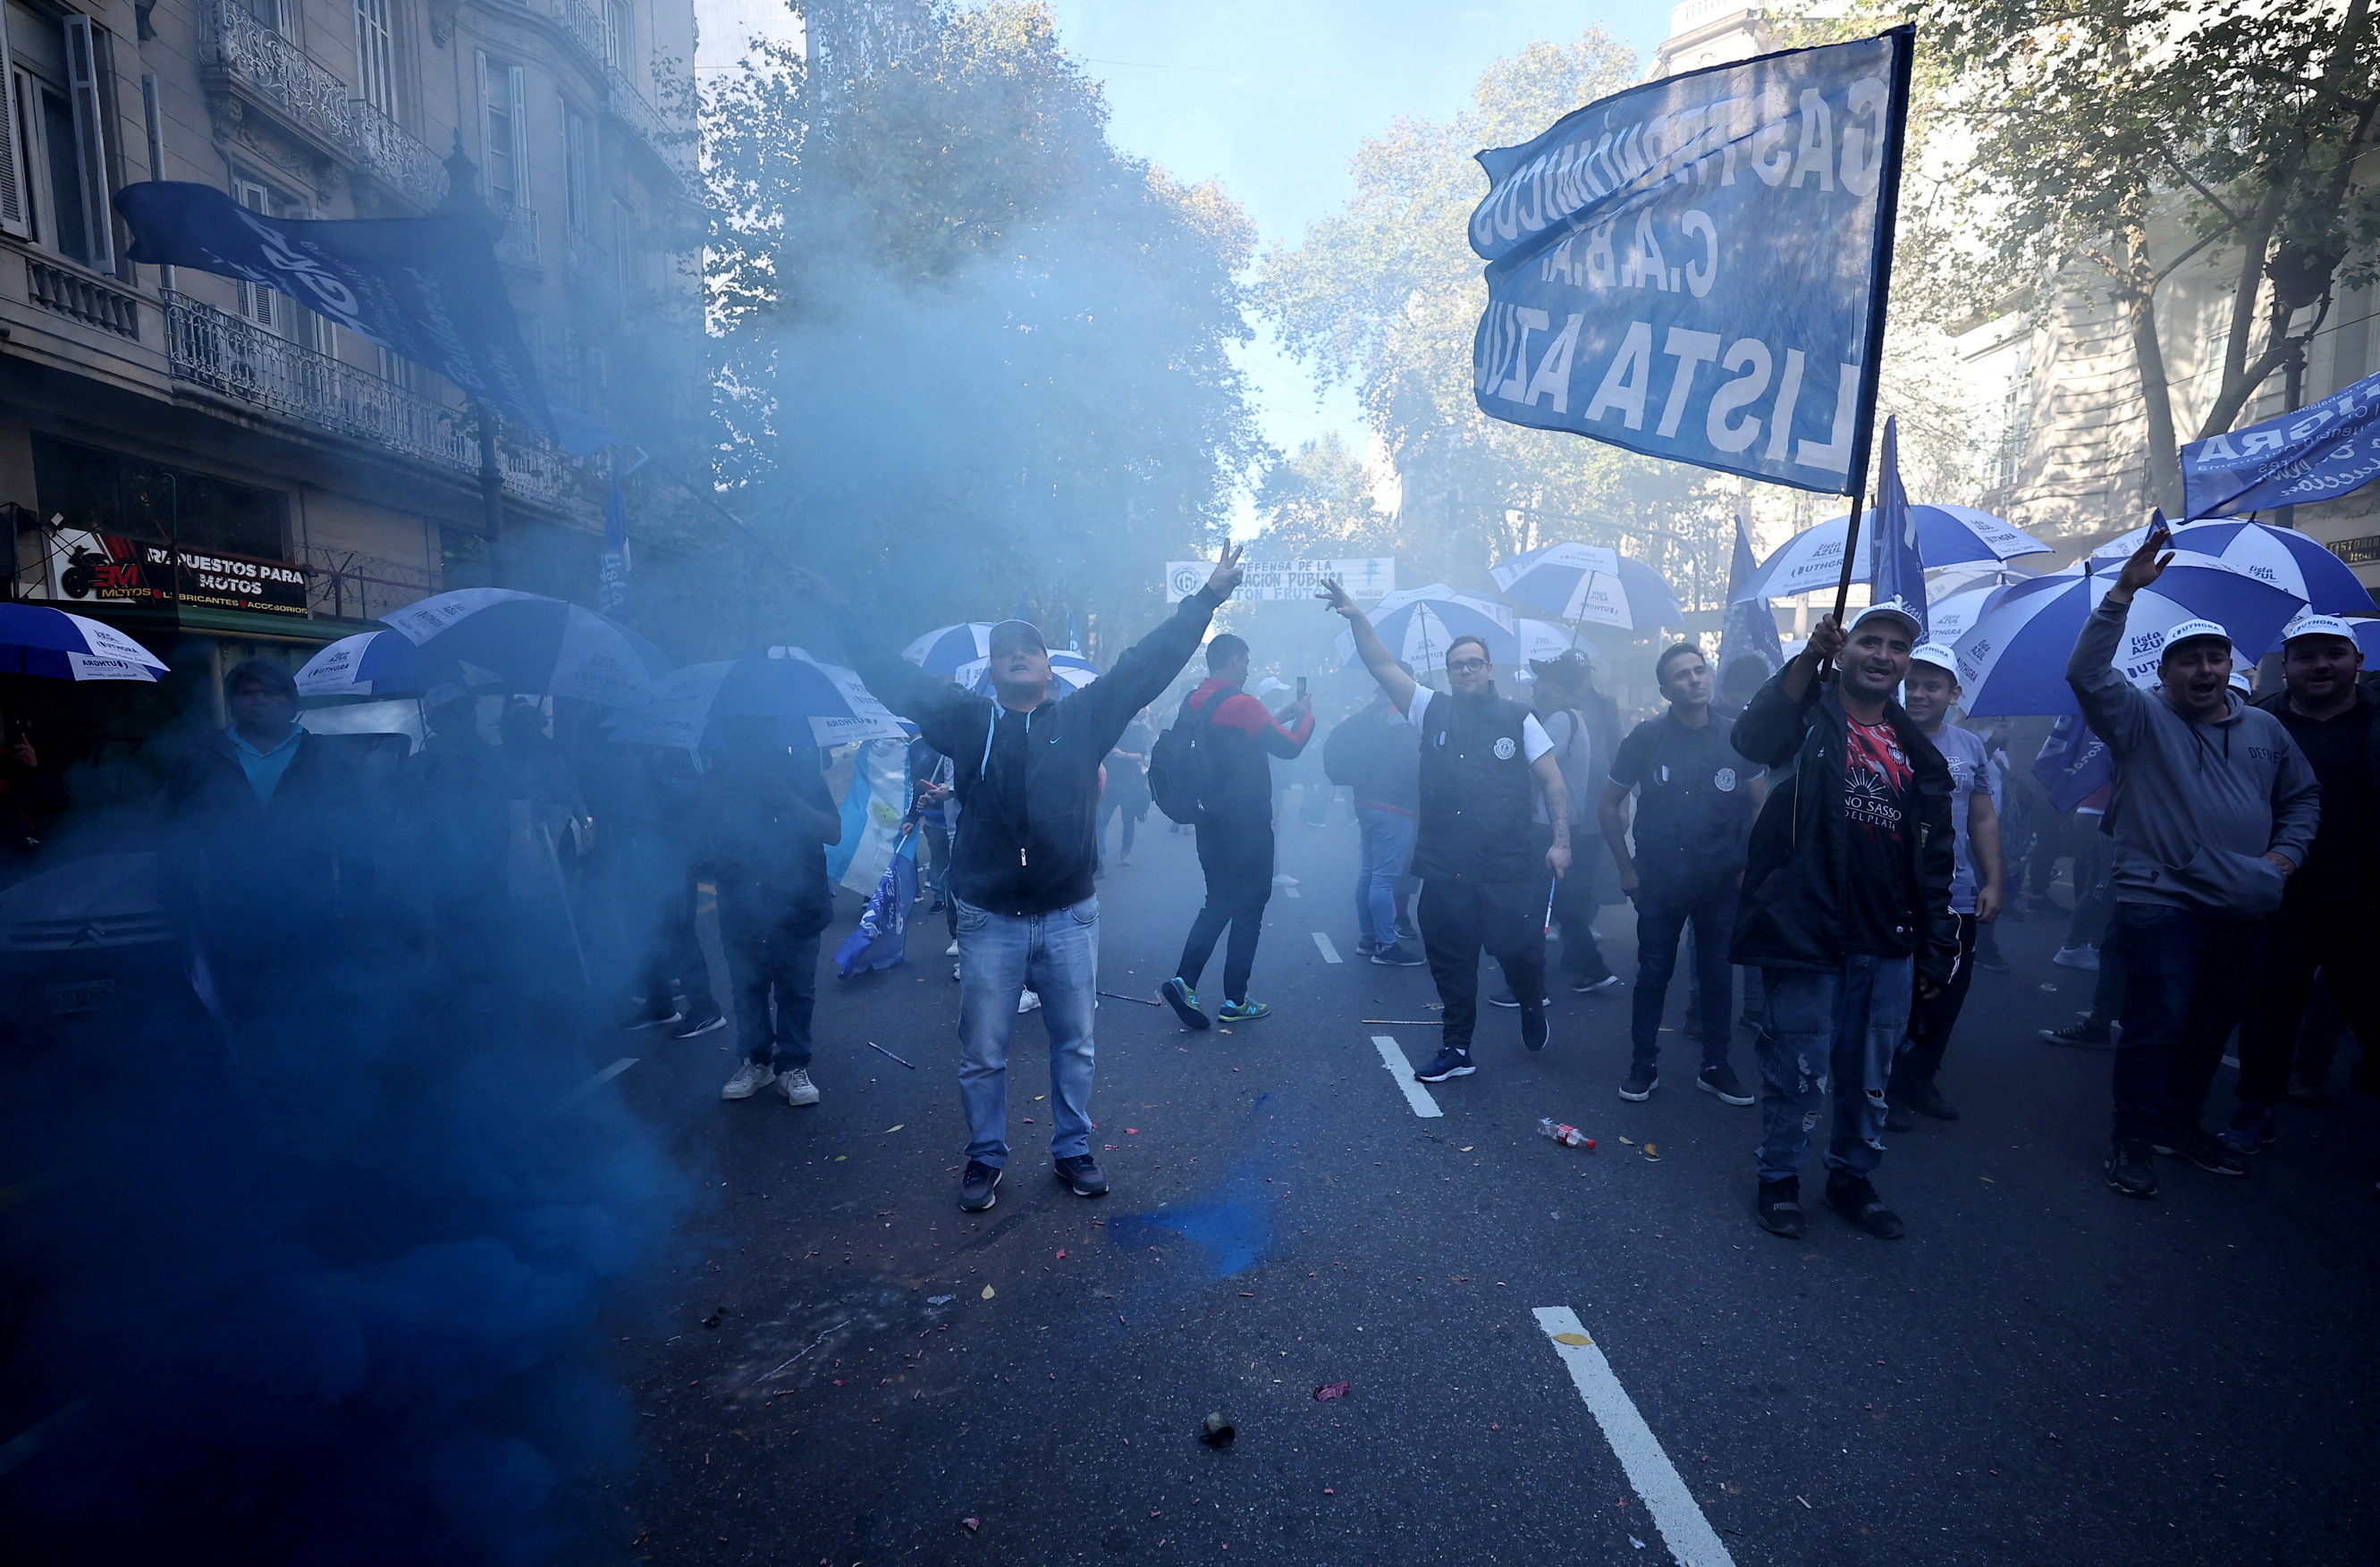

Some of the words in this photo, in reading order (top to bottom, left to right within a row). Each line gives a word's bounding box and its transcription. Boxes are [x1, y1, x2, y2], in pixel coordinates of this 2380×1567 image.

[1812, 547, 1843, 558] AZUL
[1298, 561, 1312, 571] DE
[1317, 560, 1332, 571] LA
[1805, 559, 1844, 572] UTHGR
[2249, 565, 2274, 573] Lista
[260, 567, 305, 585] PARA
[199, 574, 263, 594] MOTOS
[102, 588, 152, 597] MOTOS
[163, 592, 239, 606] LBRICANTES
[247, 602, 308, 614] ACCESORIOS
[2182, 623, 2220, 632] UTHGRA
[2301, 619, 2339, 628] UTHGRA
[2131, 631, 2162, 646] Lista
[1920, 646, 1949, 658] UTHGRA
[1970, 646, 1987, 661] AZUL
[317, 663, 350, 674] UTHGRA
[1958, 659, 1979, 683] UTHGRA
[2137, 659, 2162, 673] UT
[1867, 801, 1902, 821] SASSO
[1868, 815, 1896, 832] PLATA
